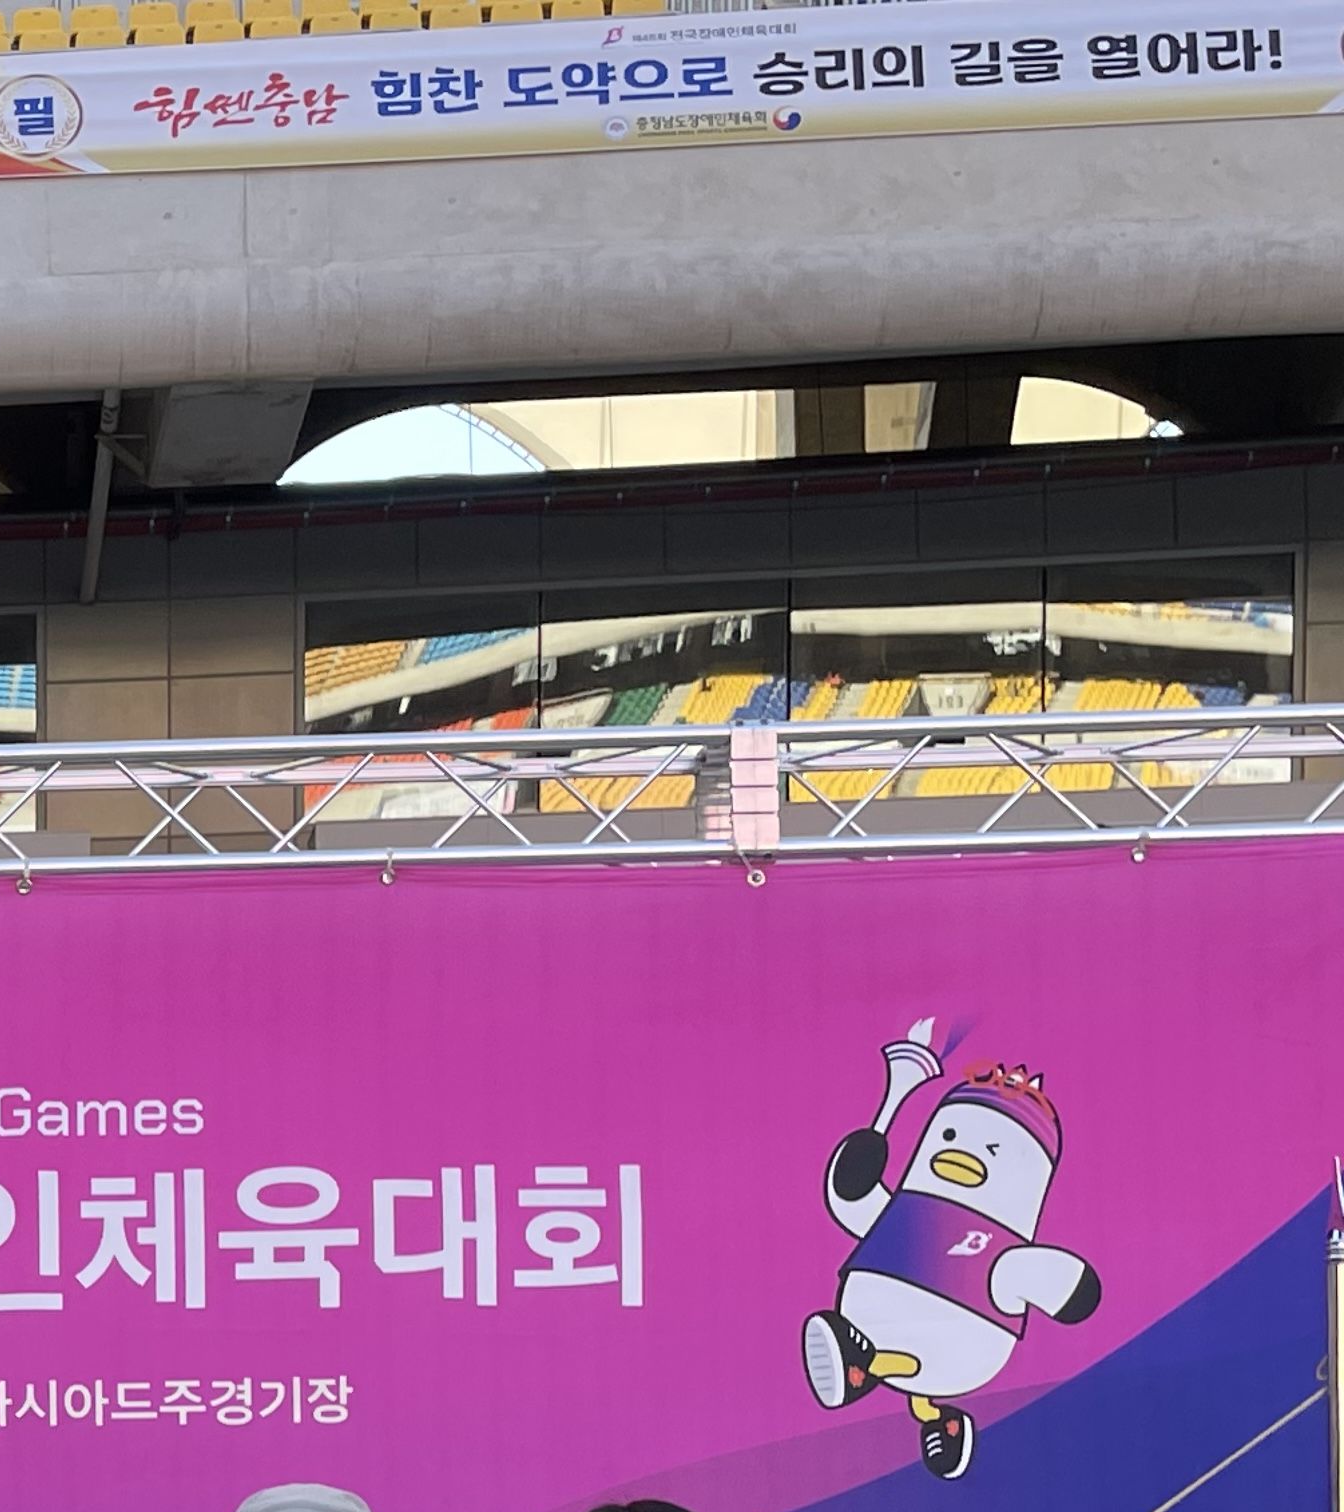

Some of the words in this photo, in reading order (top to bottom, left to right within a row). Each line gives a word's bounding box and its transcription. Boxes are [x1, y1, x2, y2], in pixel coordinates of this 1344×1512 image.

[370, 67, 482, 118] 힘찬
[502, 56, 734, 108] 도약으로
[752, 45, 925, 96] 승리의
[949, 38, 1064, 88] 길을
[1085, 28, 1283, 80] 열어라!
[13, 95, 55, 137] 필
